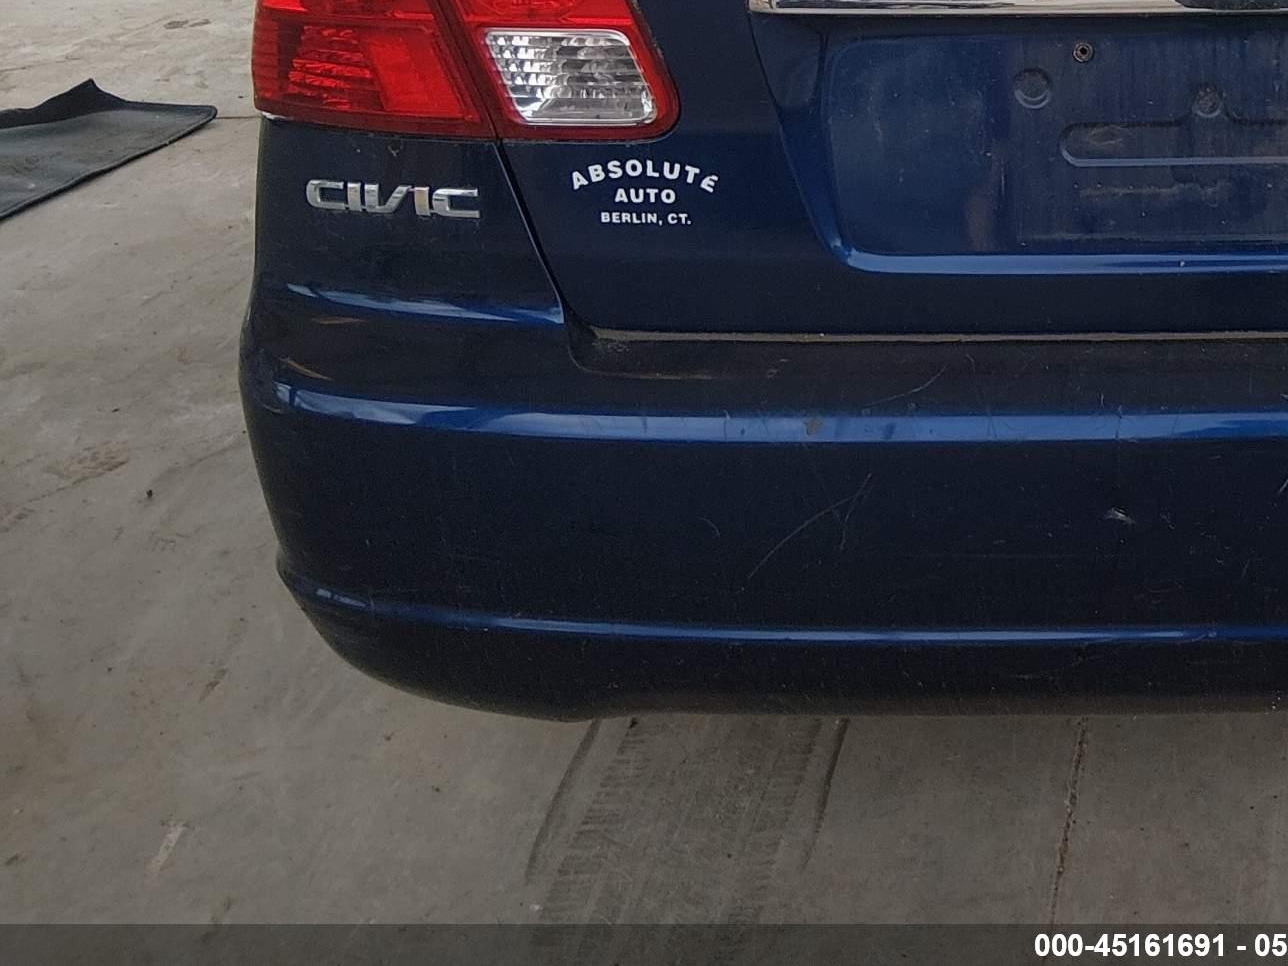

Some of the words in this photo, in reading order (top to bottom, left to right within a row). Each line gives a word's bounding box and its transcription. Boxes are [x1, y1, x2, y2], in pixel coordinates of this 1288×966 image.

[572, 159, 719, 193] ABSOLUTE
[306, 180, 481, 219] CIVIC
[614, 188, 676, 204] AUTO
[600, 211, 663, 226] BERLIN,
[667, 213, 692, 225] CT.
